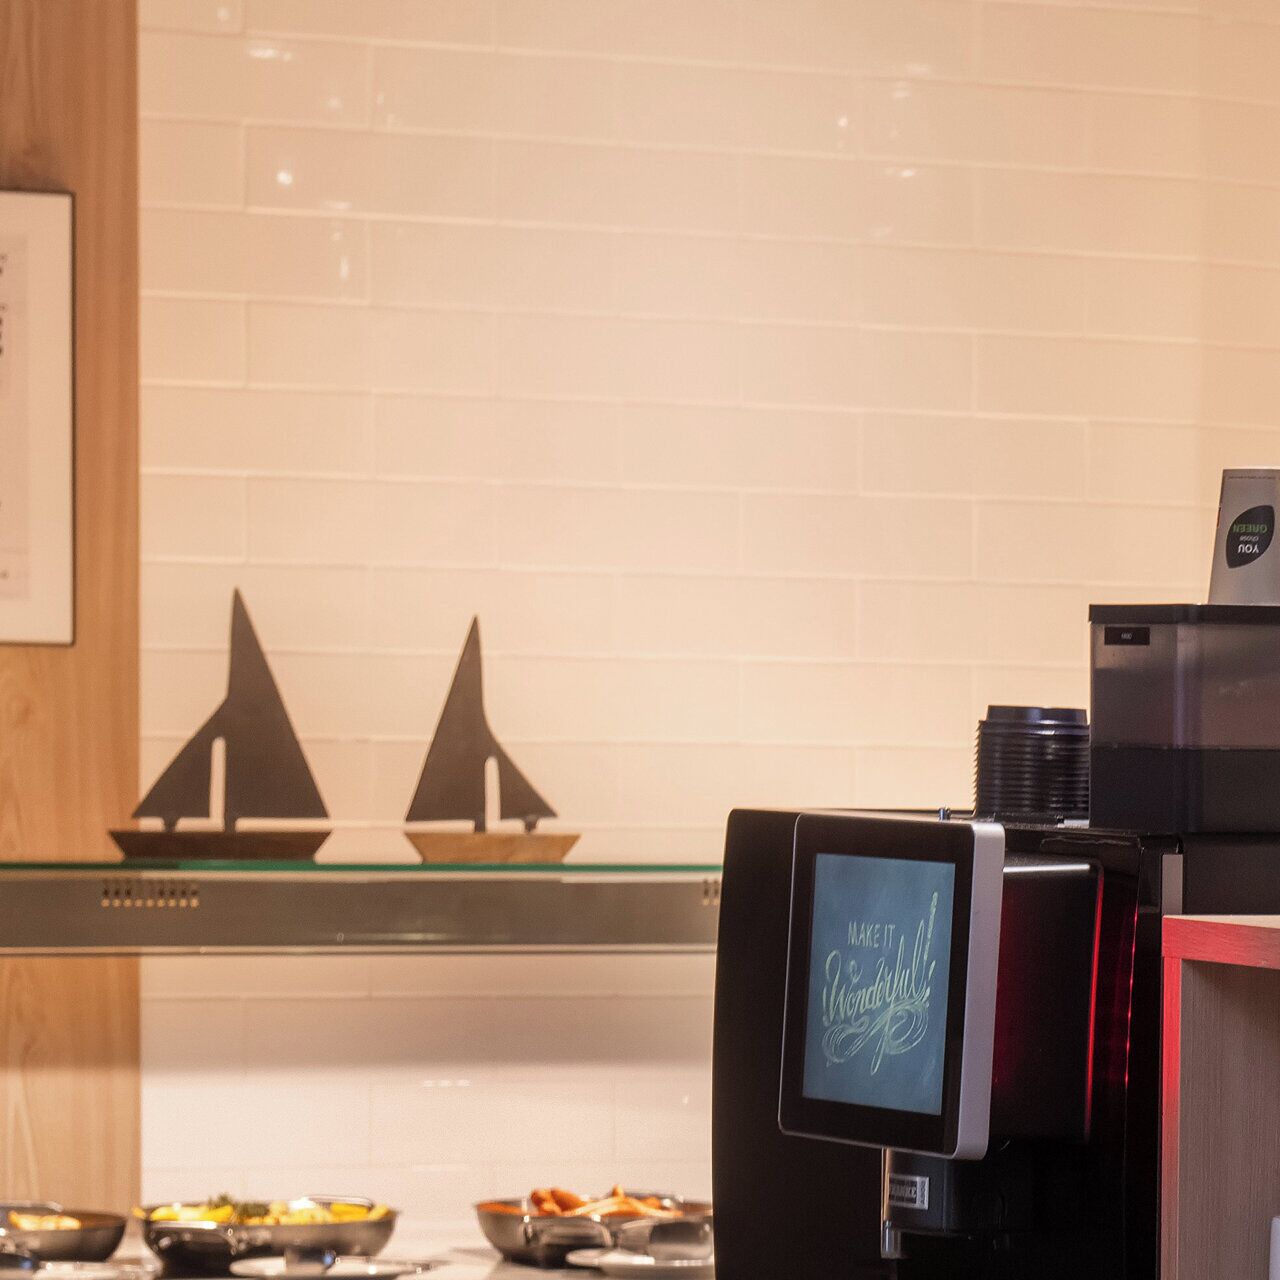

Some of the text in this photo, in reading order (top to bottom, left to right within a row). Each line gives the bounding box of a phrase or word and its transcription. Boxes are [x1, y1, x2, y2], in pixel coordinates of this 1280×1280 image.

[1237, 544, 1260, 554] YOU
[848, 921, 896, 948] MAKE IT
